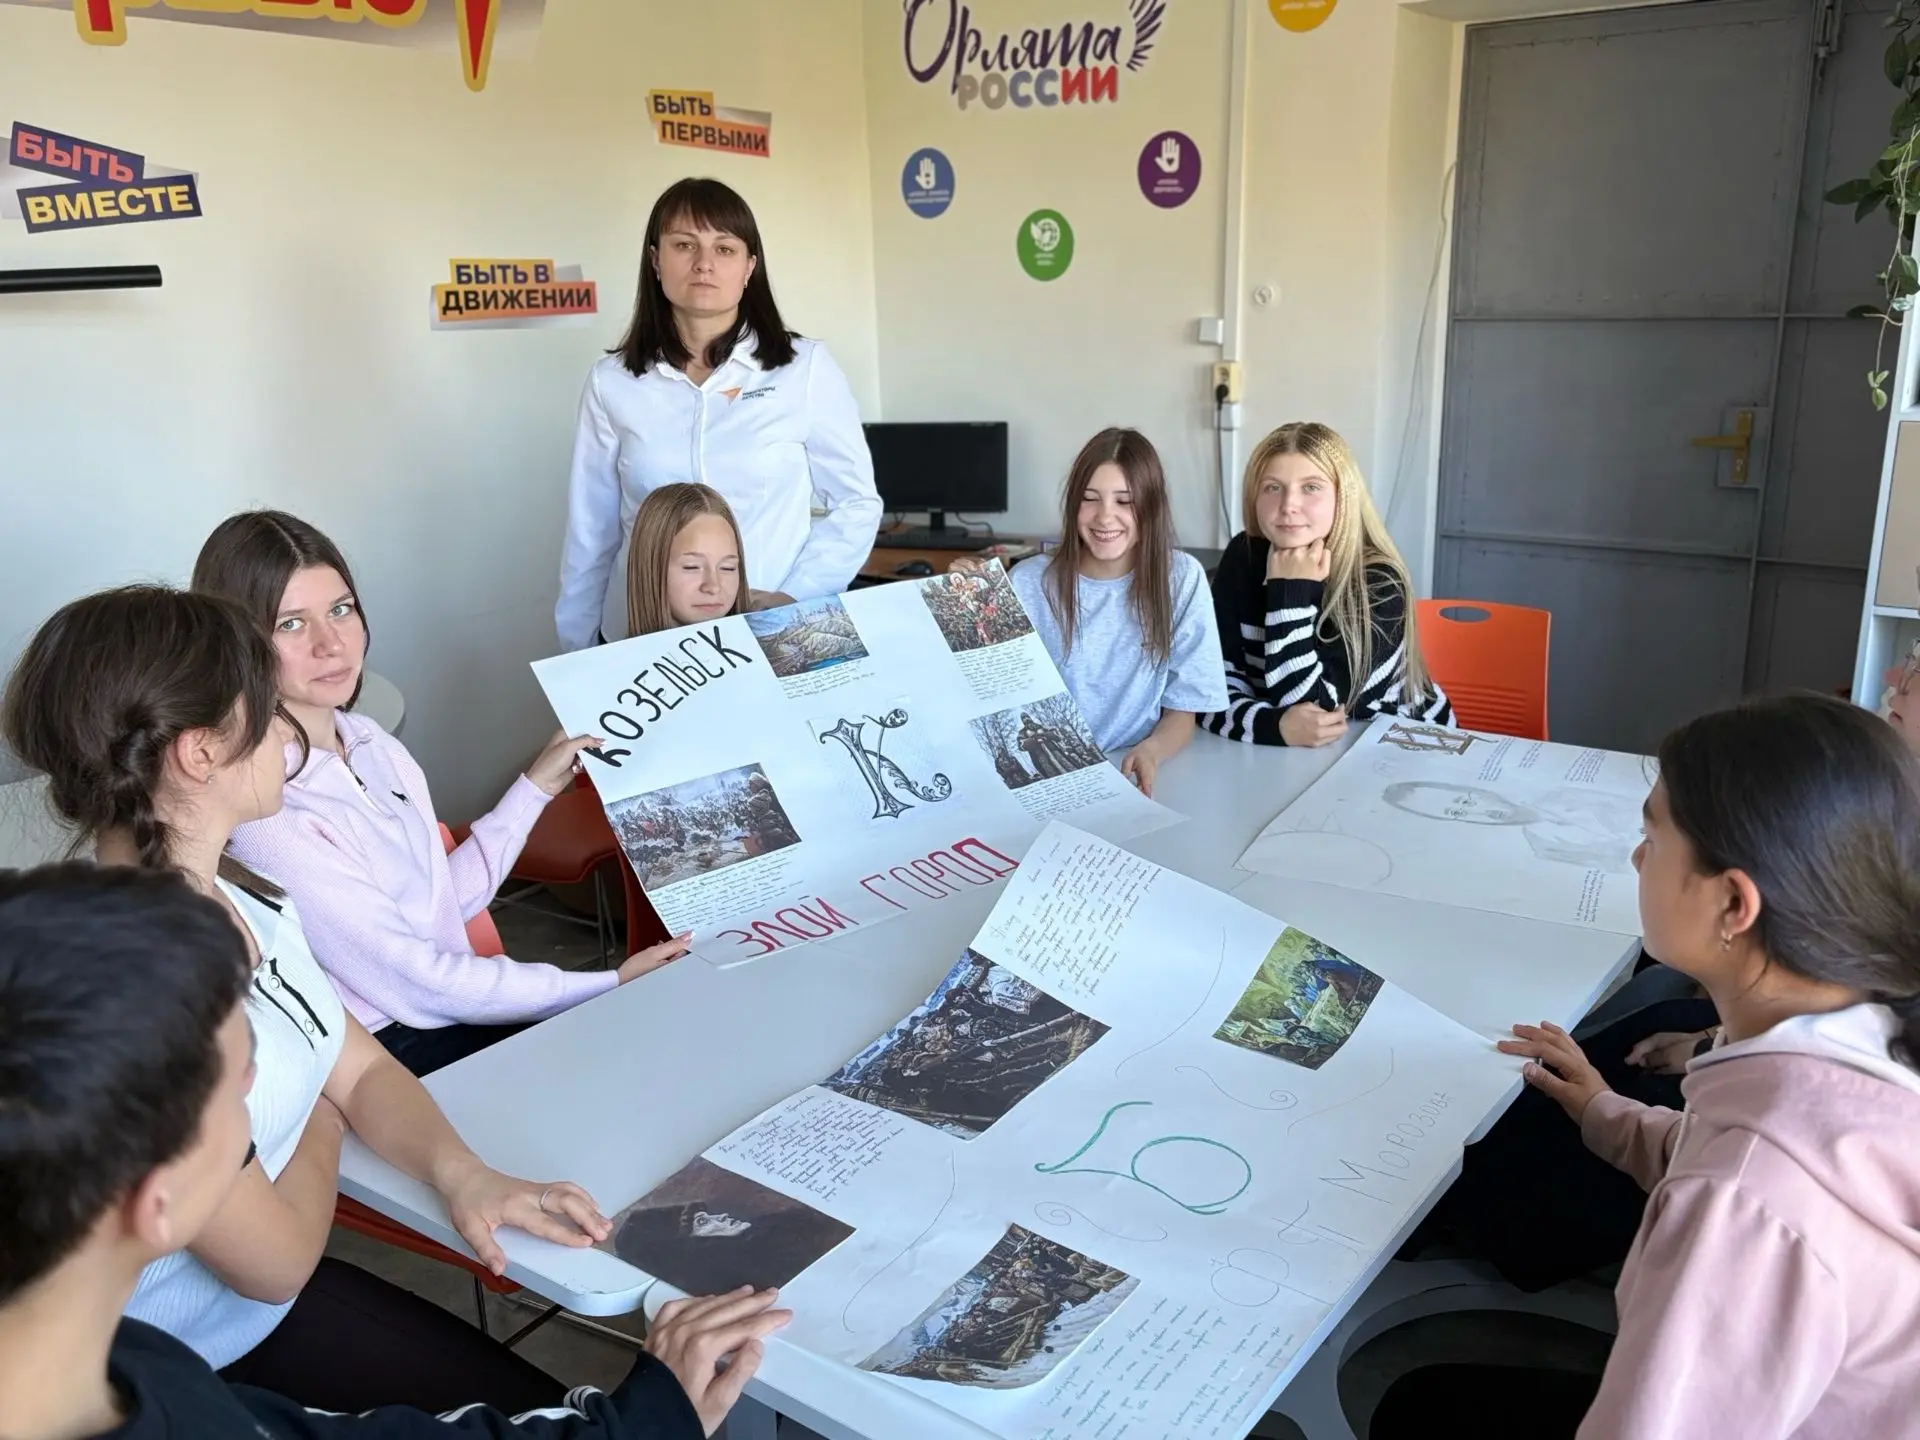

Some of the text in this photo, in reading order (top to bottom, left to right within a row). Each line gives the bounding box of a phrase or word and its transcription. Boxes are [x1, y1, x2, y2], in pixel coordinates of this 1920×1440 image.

[653, 94, 711, 117] БЫТЬ
[957, 65, 1118, 110] РОССИИ
[661, 120, 767, 151] ПЕРВЫМИ
[15, 130, 135, 184] БЫТЬ
[26, 183, 194, 225] ВМЕСТЕ
[455, 264, 550, 285] БЫТЬ В
[442, 288, 592, 315] ДВИЖЕНИИ
[859, 837, 1020, 911] ГОРОД
[715, 895, 860, 958] ЗЛОЙ
